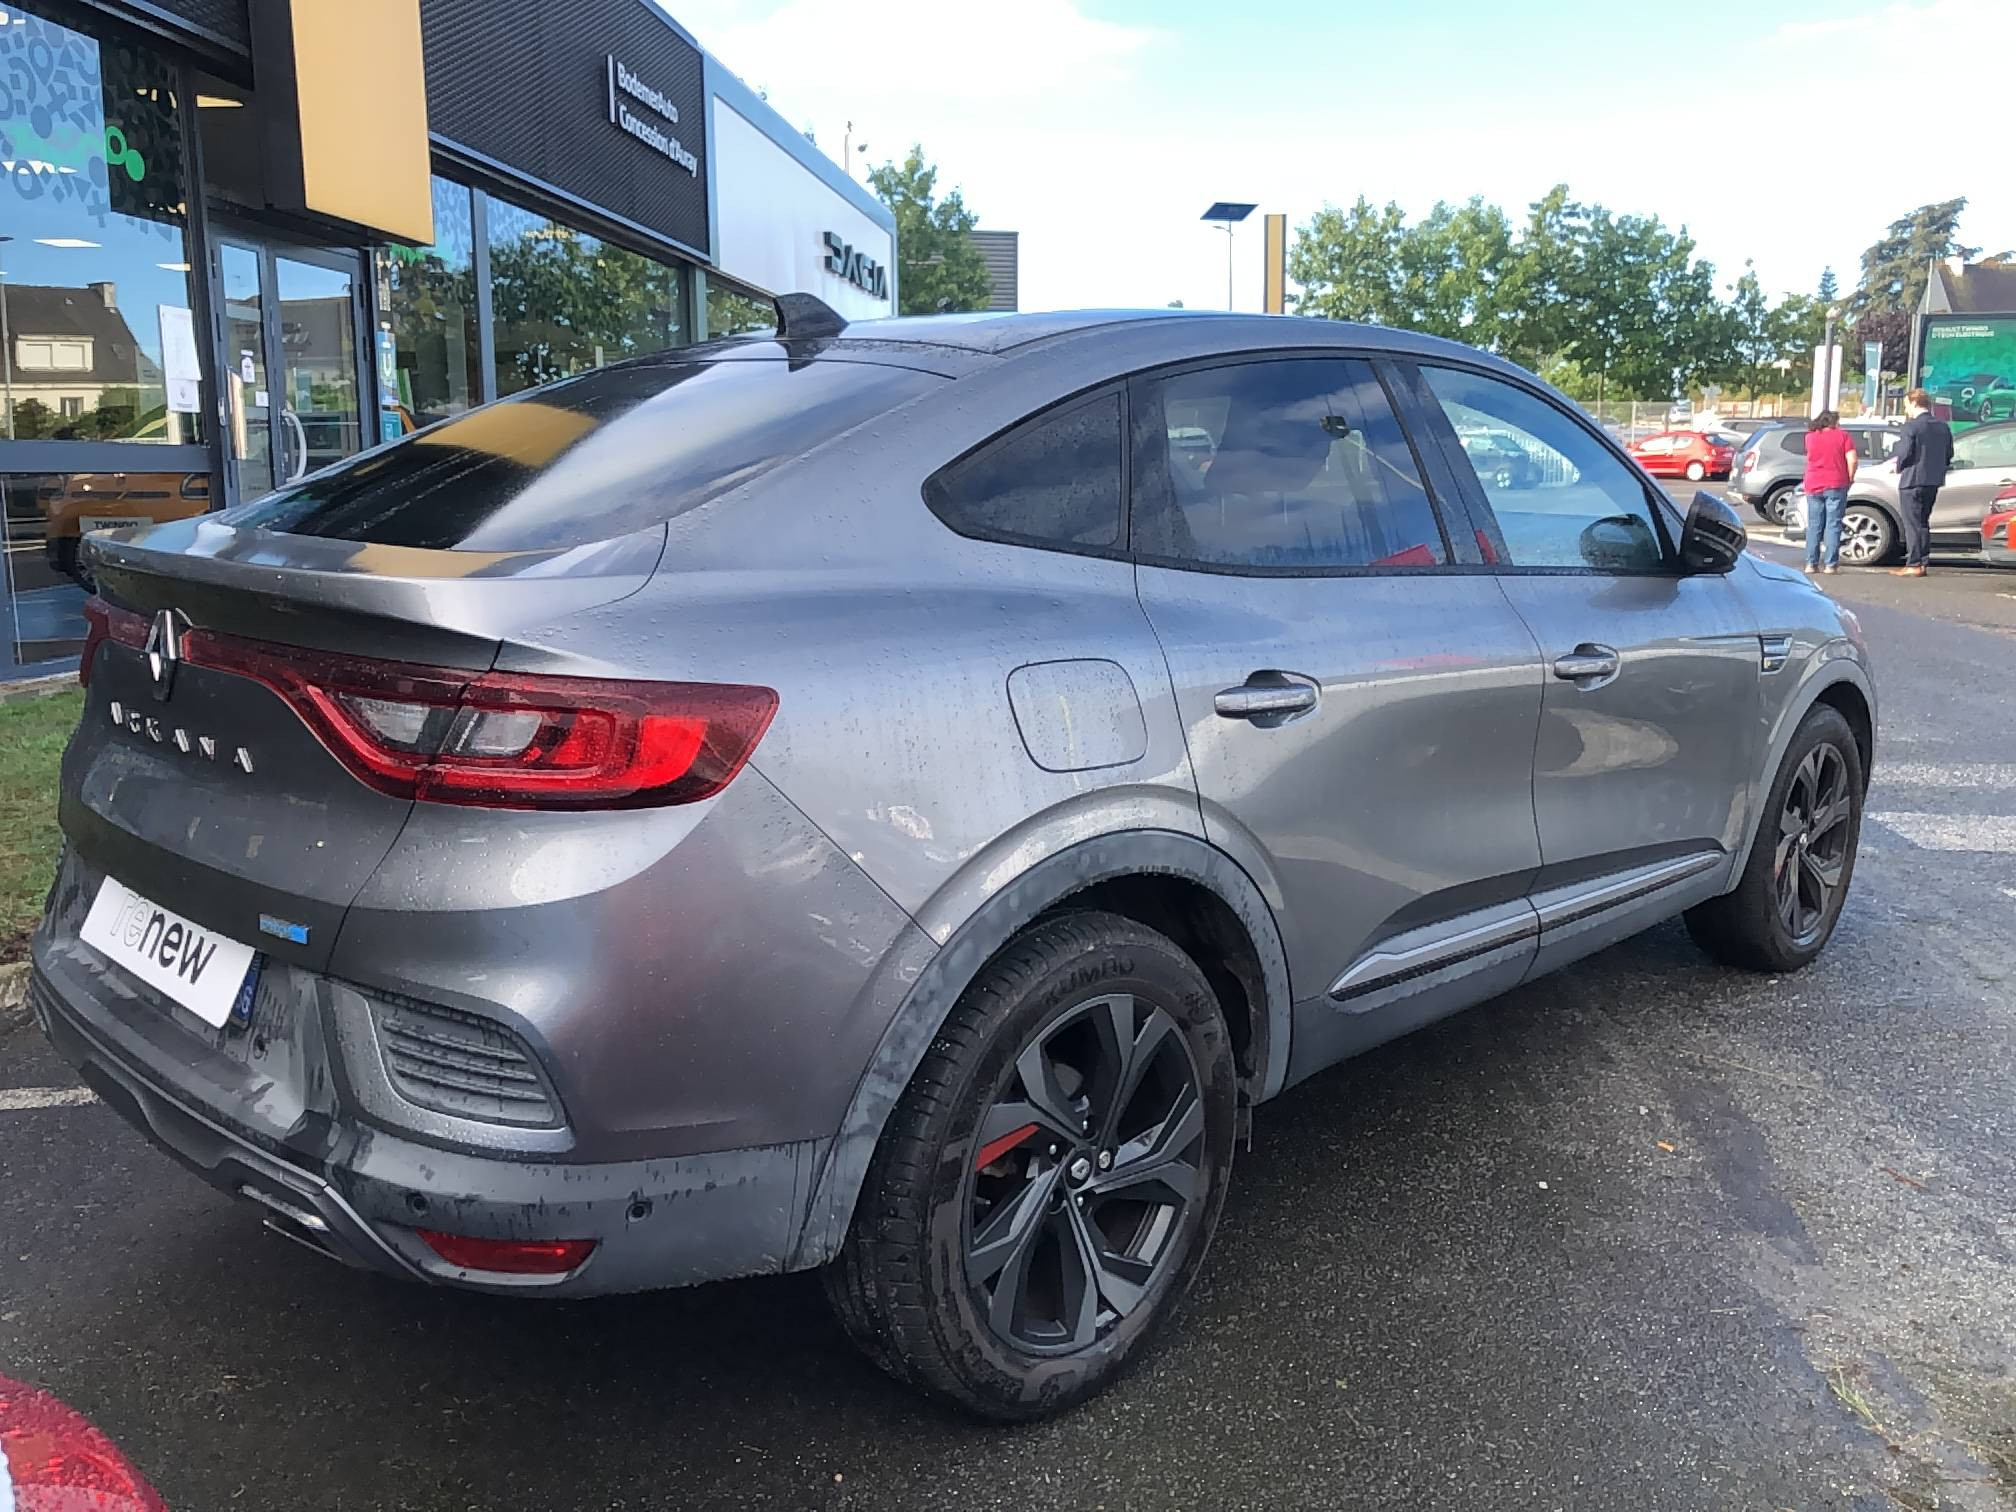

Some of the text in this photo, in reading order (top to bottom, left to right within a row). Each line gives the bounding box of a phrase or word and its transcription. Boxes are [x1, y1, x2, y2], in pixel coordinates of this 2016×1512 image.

[620, 104, 698, 178] Concession d'Auray
[823, 231, 888, 300] DACIA
[111, 893, 218, 986] renew
